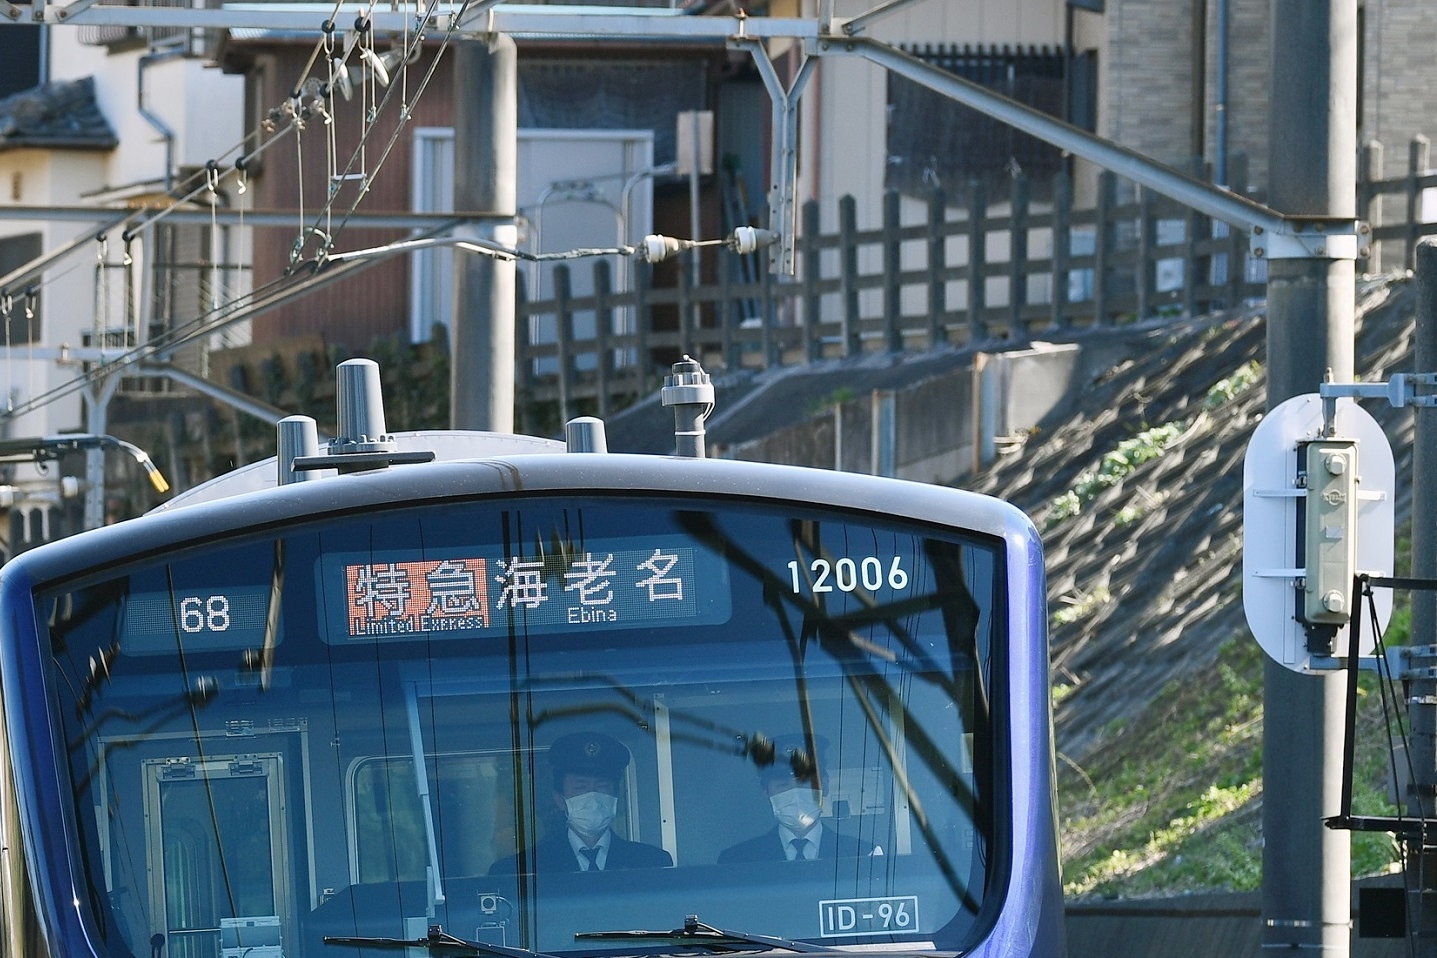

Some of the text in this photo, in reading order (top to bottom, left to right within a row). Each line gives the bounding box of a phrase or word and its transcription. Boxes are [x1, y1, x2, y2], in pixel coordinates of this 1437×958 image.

[356, 549, 683, 617] 特急 海老名
[787, 556, 908, 594] 12006
[180, 595, 230, 633] 68
[355, 617, 413, 635] Limited
[567, 606, 617, 624] Ebina
[828, 902, 910, 931] ID-96
